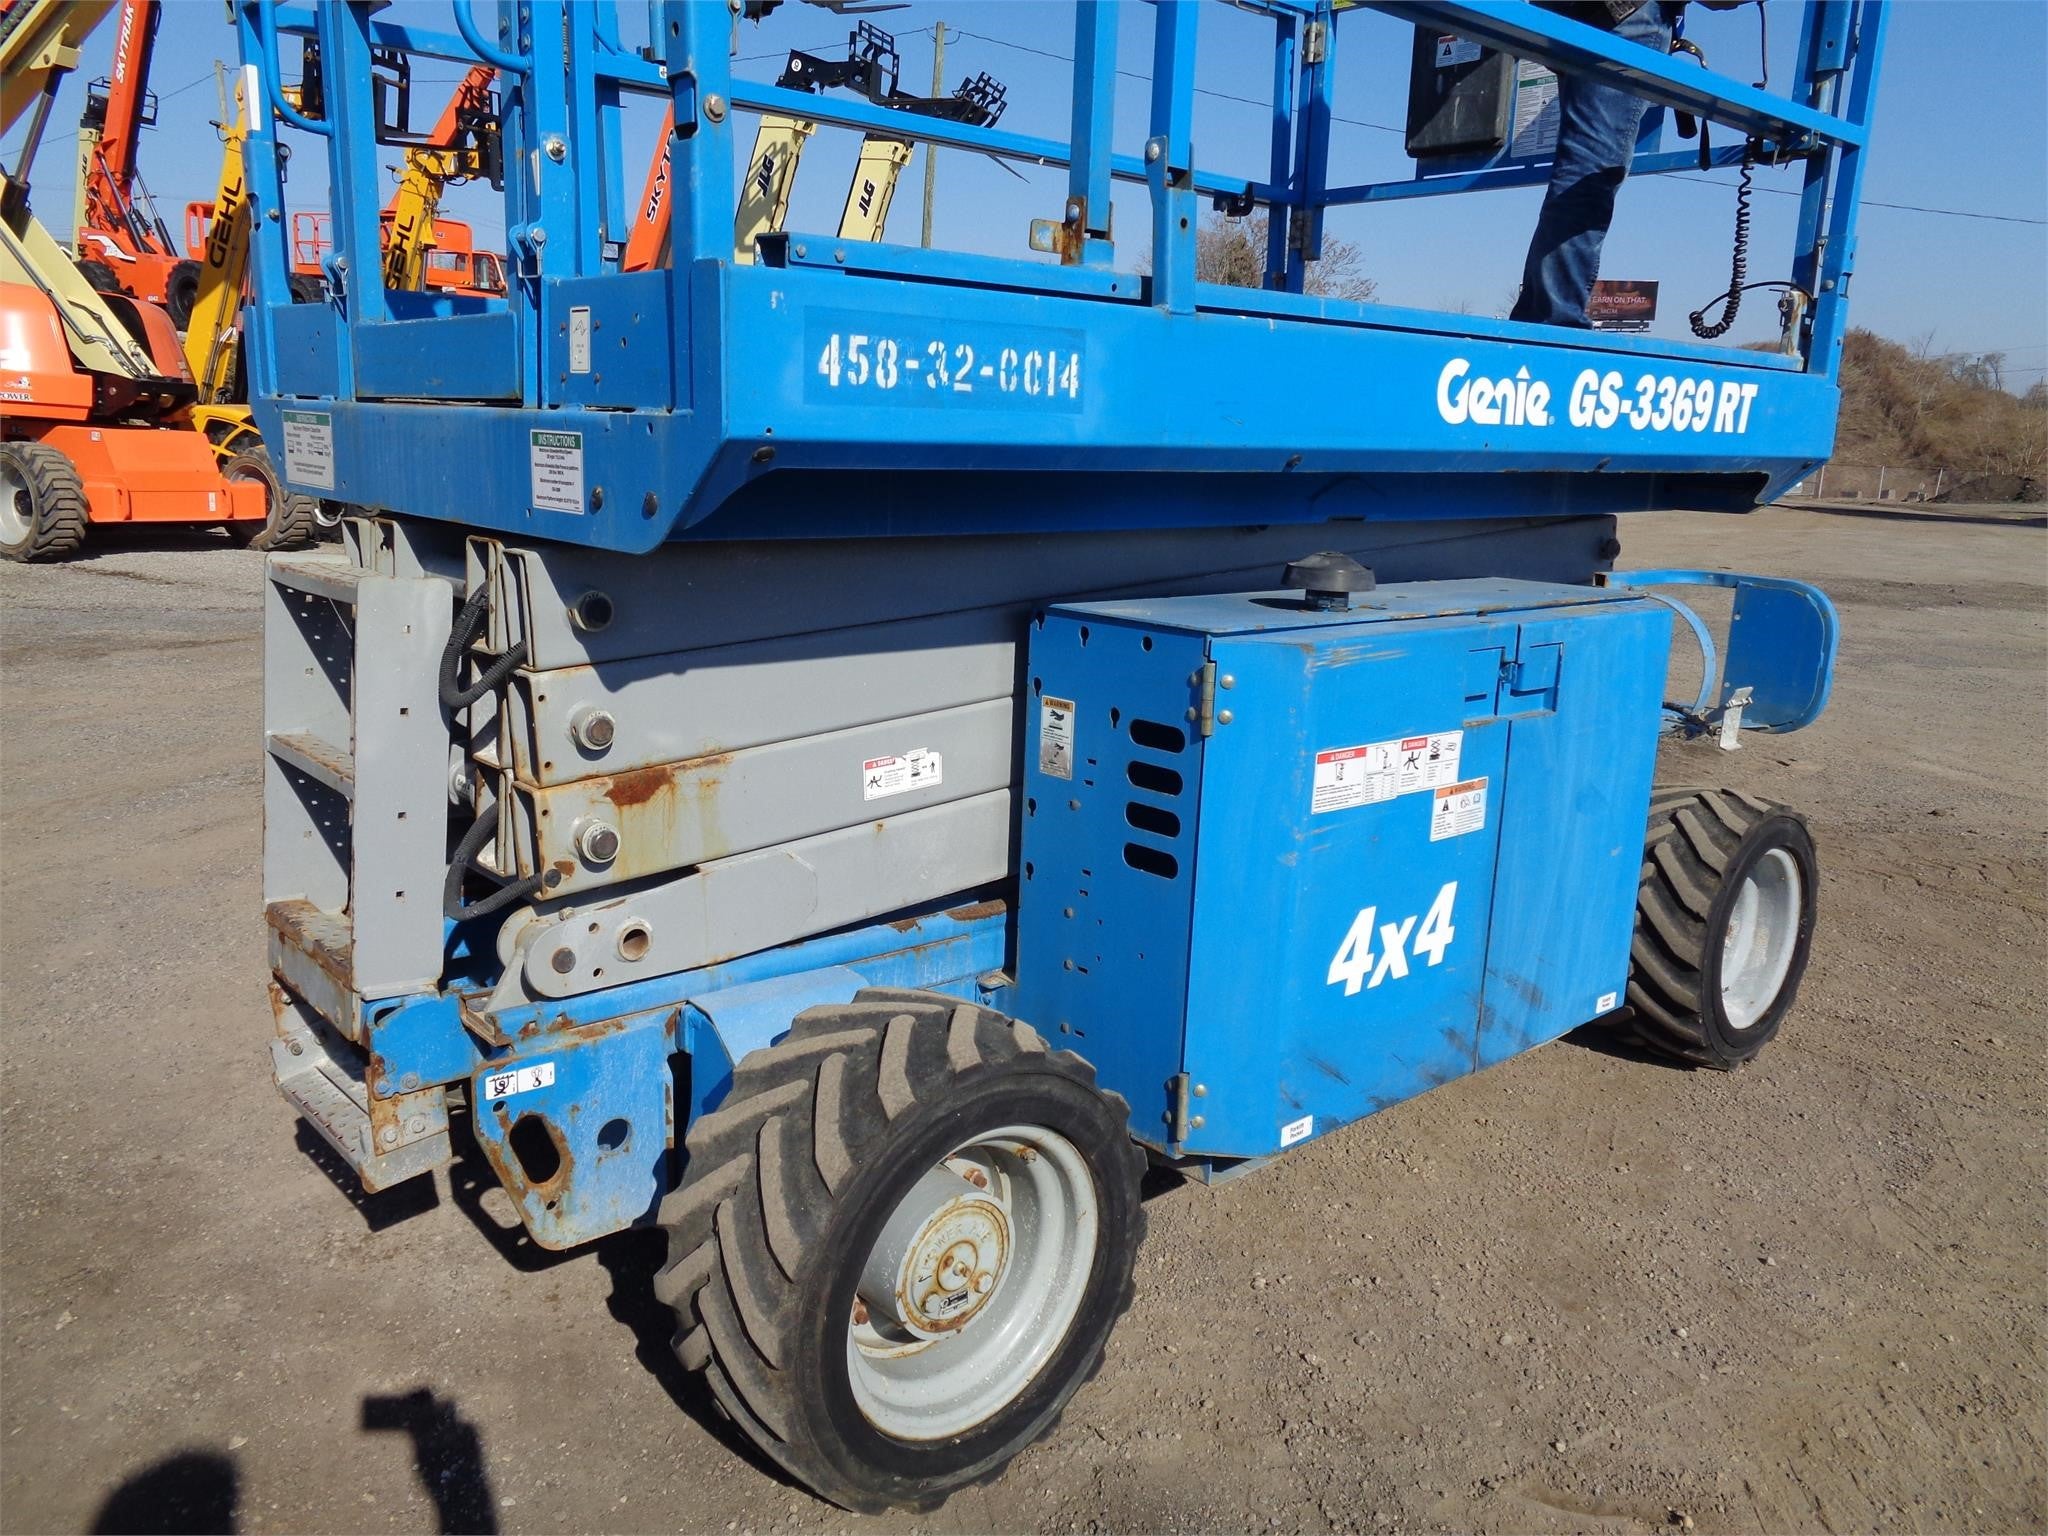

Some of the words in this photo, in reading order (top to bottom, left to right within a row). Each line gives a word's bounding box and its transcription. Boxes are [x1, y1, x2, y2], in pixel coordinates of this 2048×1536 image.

[115, 0, 134, 84] SKYTRAK
[646, 128, 673, 224] SKYT
[756, 154, 775, 198] JLG
[858, 179, 876, 218] JLG
[208, 176, 242, 269] GEHL
[386, 215, 414, 289] GEHL
[1614, 296, 1625, 304] ON
[538, 433, 576, 447] INSTRUCTIONS
[1335, 751, 1355, 760] DANGER
[1407, 740, 1427, 748] DANGER
[1326, 880, 1458, 997] 4x4
